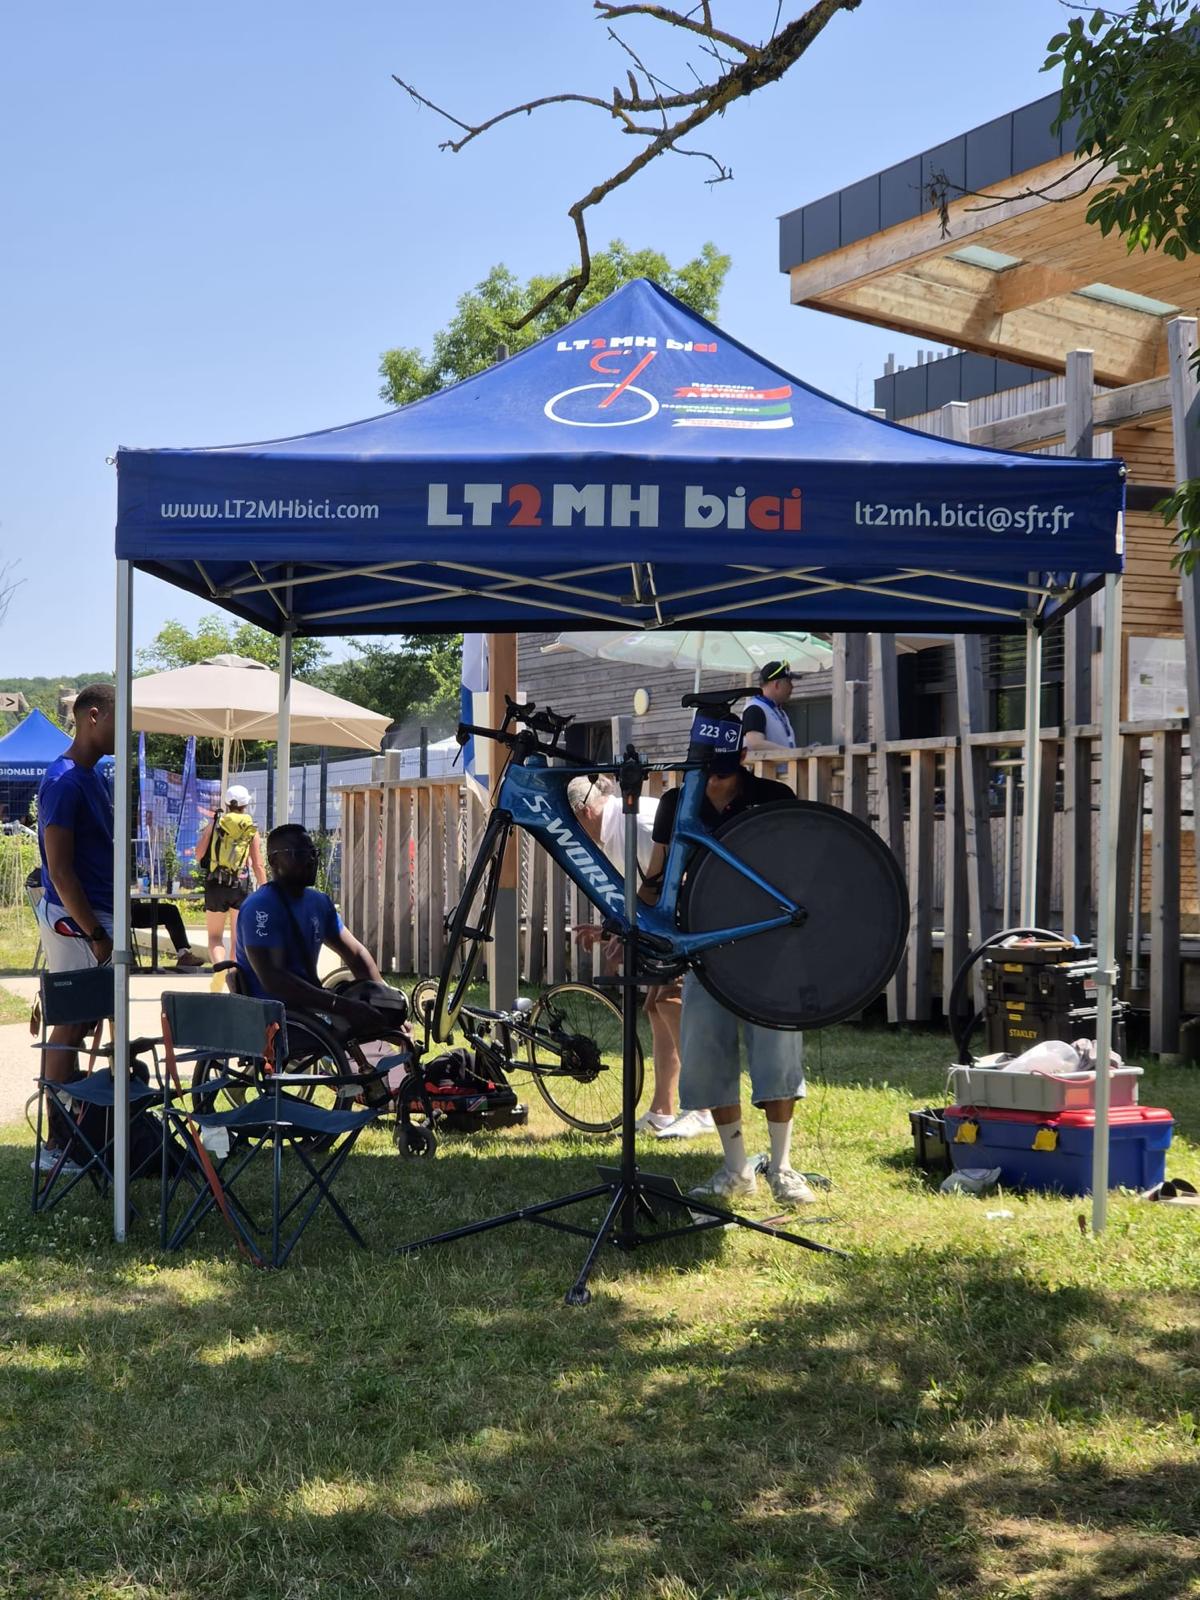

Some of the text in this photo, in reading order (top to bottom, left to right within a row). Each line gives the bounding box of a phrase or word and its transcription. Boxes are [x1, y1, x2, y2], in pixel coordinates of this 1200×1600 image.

[557, 336, 718, 353] LT2MH bici
[160, 500, 380, 520] www.LT2MHbici.com
[428, 483, 802, 531] LT2MH bici
[855, 500, 1075, 535] lt2mh.bici@sfr.fr
[699, 724, 720, 738] 223
[522, 795, 642, 918] S-WORK
[1009, 1028, 1037, 1039] STANLEY
